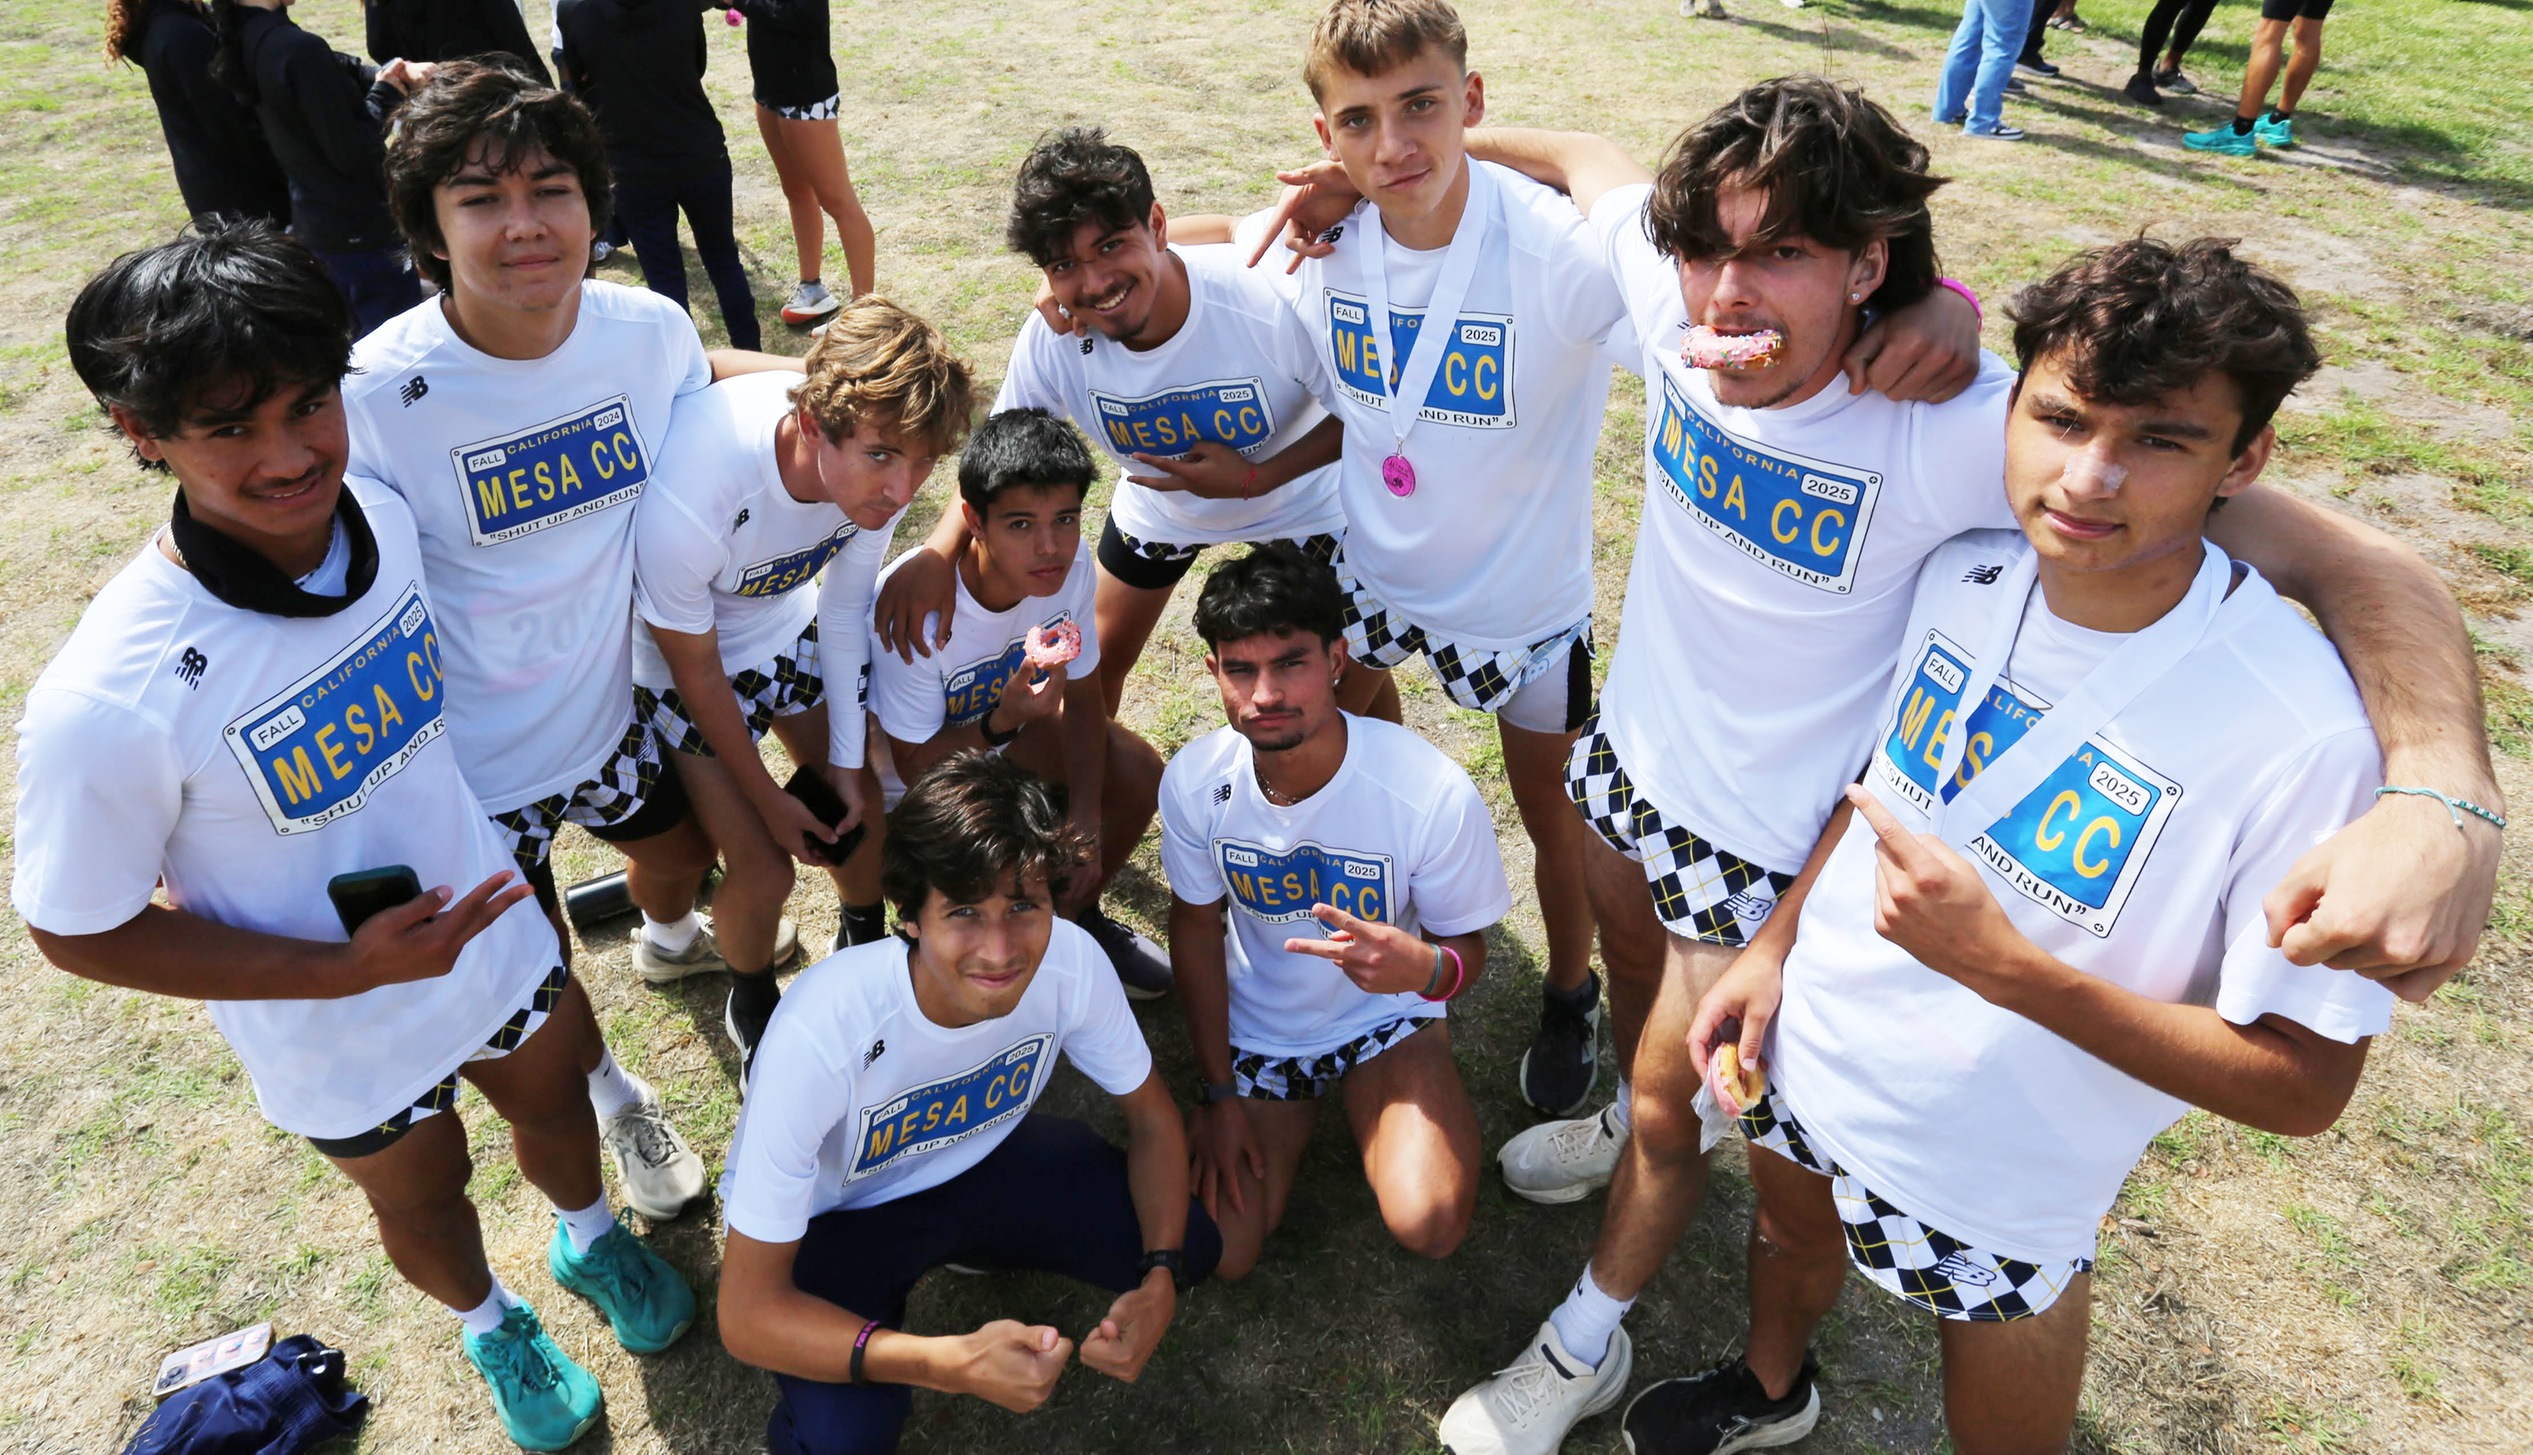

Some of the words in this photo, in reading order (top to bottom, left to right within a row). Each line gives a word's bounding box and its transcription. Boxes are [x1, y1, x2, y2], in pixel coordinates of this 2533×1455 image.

[1335, 307, 1361, 321] FALL
[1465, 329, 1497, 342] 2025
[1336, 328, 1399, 385] ME
[1445, 351, 1497, 401] CC
[1102, 402, 1126, 415] FALL
[1128, 389, 1217, 413] CALIFORNIA
[1222, 390, 1250, 401] 2025
[1107, 412, 1202, 448] MESA
[1213, 406, 1262, 441] CC
[471, 453, 502, 469] FALL
[506, 418, 593, 456] CALIFORNIA
[596, 411, 621, 428] 2024
[1238, 436, 1268, 456] UN"
[1687, 410, 1798, 480] CALIFORNIA
[1806, 480, 1852, 502] 2025
[476, 453, 583, 520] MESA
[590, 431, 638, 480] CC
[1661, 404, 1747, 521] MESA
[1770, 498, 1845, 558] CC
[546, 511, 569, 526] UP
[572, 499, 606, 517] AND
[1696, 511, 1721, 531] UP
[1725, 531, 1766, 561] AND
[738, 561, 811, 596] MESA
[748, 567, 770, 578] FALL
[257, 713, 300, 745] FALL
[301, 625, 401, 709] CALIFORNIA
[402, 604, 425, 633] 2025
[952, 674, 973, 690] FALL
[272, 683, 404, 806] MESA
[406, 632, 443, 702] CC
[1927, 657, 1957, 688] FALL
[2095, 769, 2141, 808] 2025
[368, 761, 394, 788] UP
[399, 729, 429, 766] AND
[1897, 686, 2005, 805] MES
[2035, 789, 2122, 880] CC
[1229, 851, 1255, 864] FALL
[1259, 849, 1342, 868] CALIFORNIA
[1348, 863, 1376, 878] 2025
[1971, 835, 2014, 875] AND
[1231, 867, 1321, 906] MESA
[1331, 882, 1380, 921] CC
[1295, 910, 1316, 920] UP
[876, 1103, 904, 1122] FALL
[911, 1057, 1004, 1102] CALIFORNIA
[1008, 1044, 1035, 1062] 2025
[866, 1094, 967, 1161] MESA
[984, 1062, 1030, 1110] CC
[916, 1140, 941, 1152] UP
[944, 1127, 980, 1146] AND
